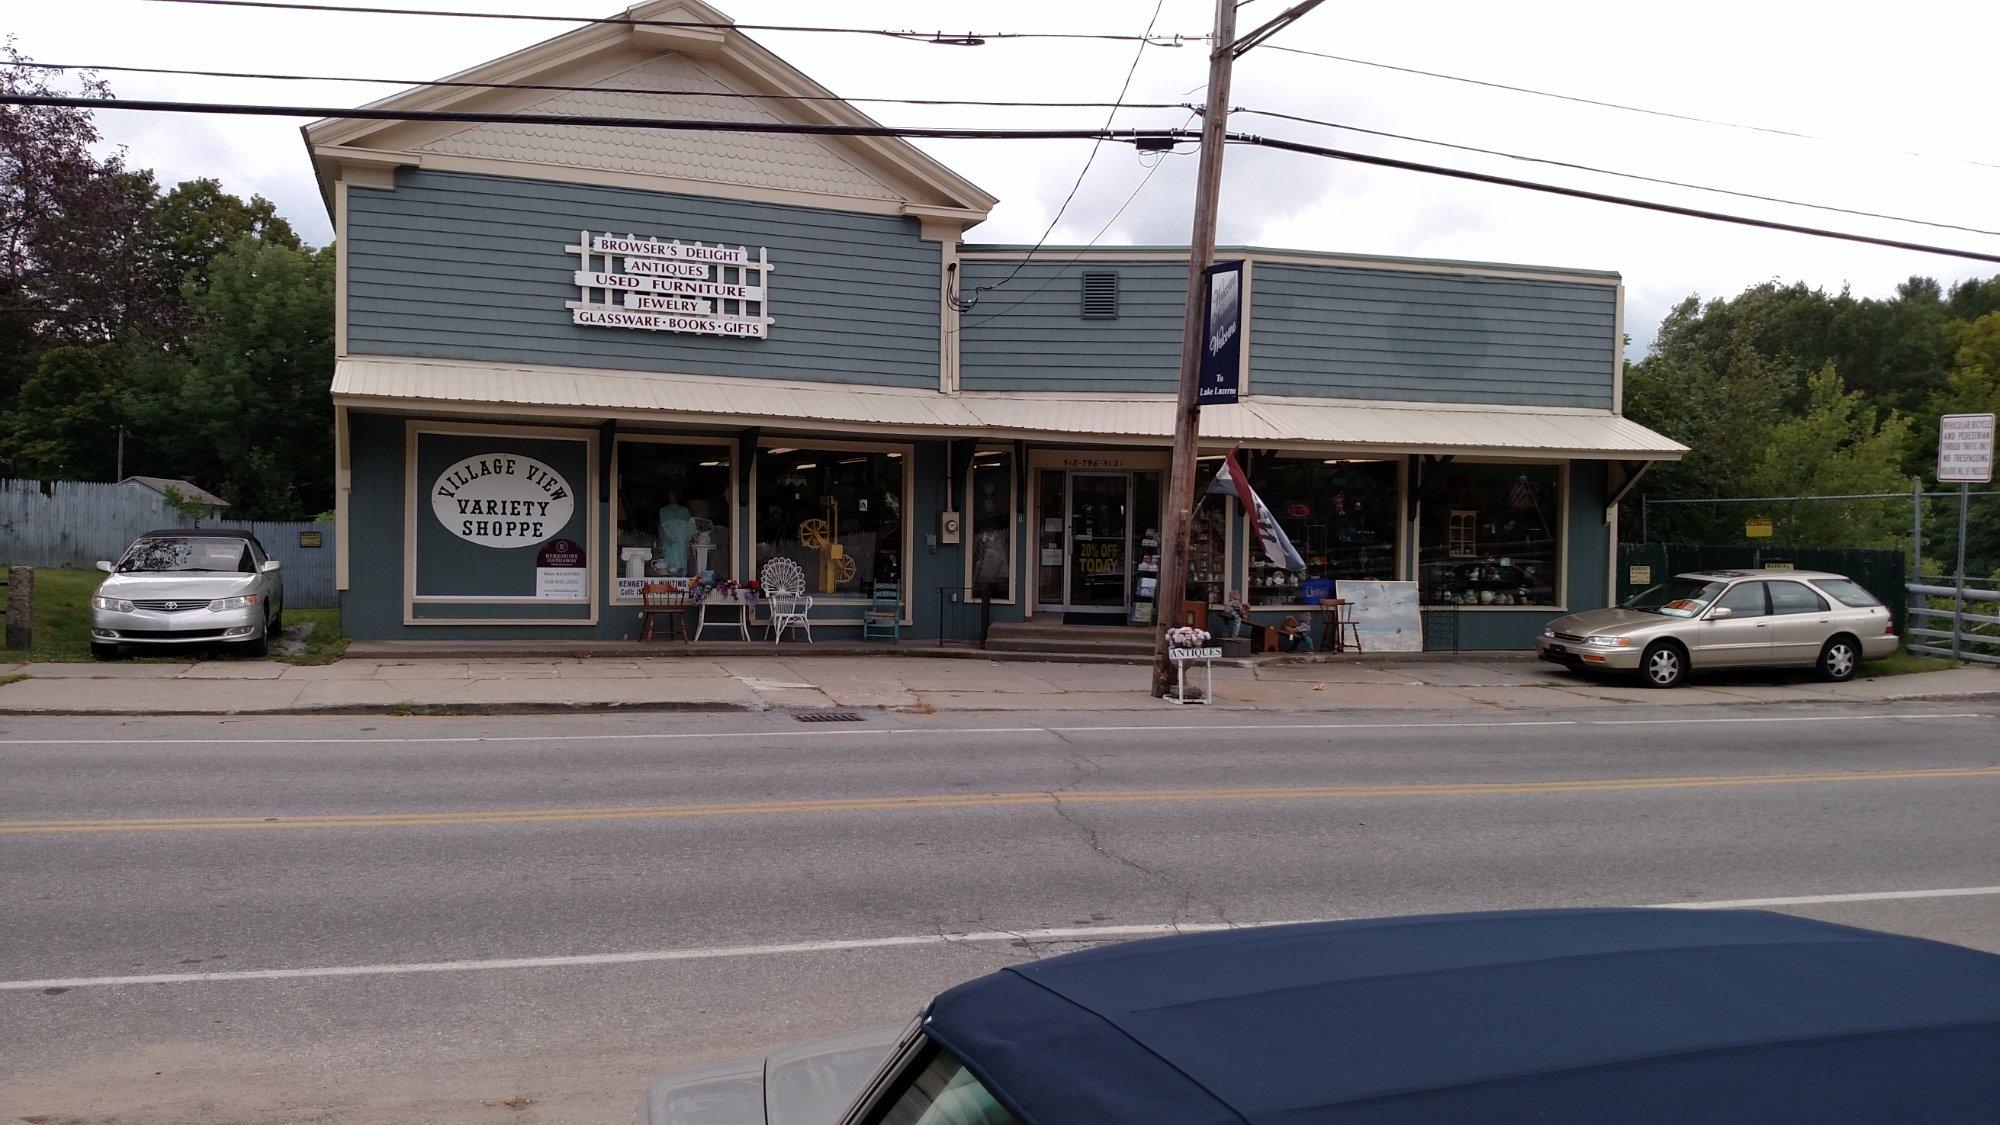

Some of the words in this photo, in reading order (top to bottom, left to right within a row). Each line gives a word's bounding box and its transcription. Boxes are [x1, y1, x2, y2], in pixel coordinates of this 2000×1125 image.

[601, 239, 678, 256] BROWSER'S
[686, 247, 741, 262] DELIGHT
[631, 260, 704, 277] ANTIQUES
[595, 274, 640, 288] USED
[652, 279, 746, 297] FURNITURE
[637, 297, 698, 312] JEWELRY
[579, 311, 660, 327] GLASSWARE
[669, 318, 715, 331] BOOKS
[724, 322, 759, 335] GIFTS
[1209, 322, 1237, 358] Welcome
[1216, 373, 1224, 383] To
[1200, 387, 1213, 396] Lake
[1214, 386, 1237, 395] Luzerne
[1944, 432, 1955, 440] AND
[1958, 431, 1990, 440] PEDESTRIAN
[1943, 454, 1951, 462] NO
[1953, 454, 1988, 463] TRESPASSING
[437, 458, 516, 499] VILLAGE
[526, 464, 568, 501] VIEW
[457, 499, 550, 517] VARIETY
[462, 520, 543, 538] SHOPPE
[1080, 543, 1099, 557] 20%
[1101, 543, 1118, 558] OFF
[1079, 558, 1118, 573] TODAY
[618, 580, 648, 588] KENNETH
[1171, 648, 1221, 658] ANTIQUES
